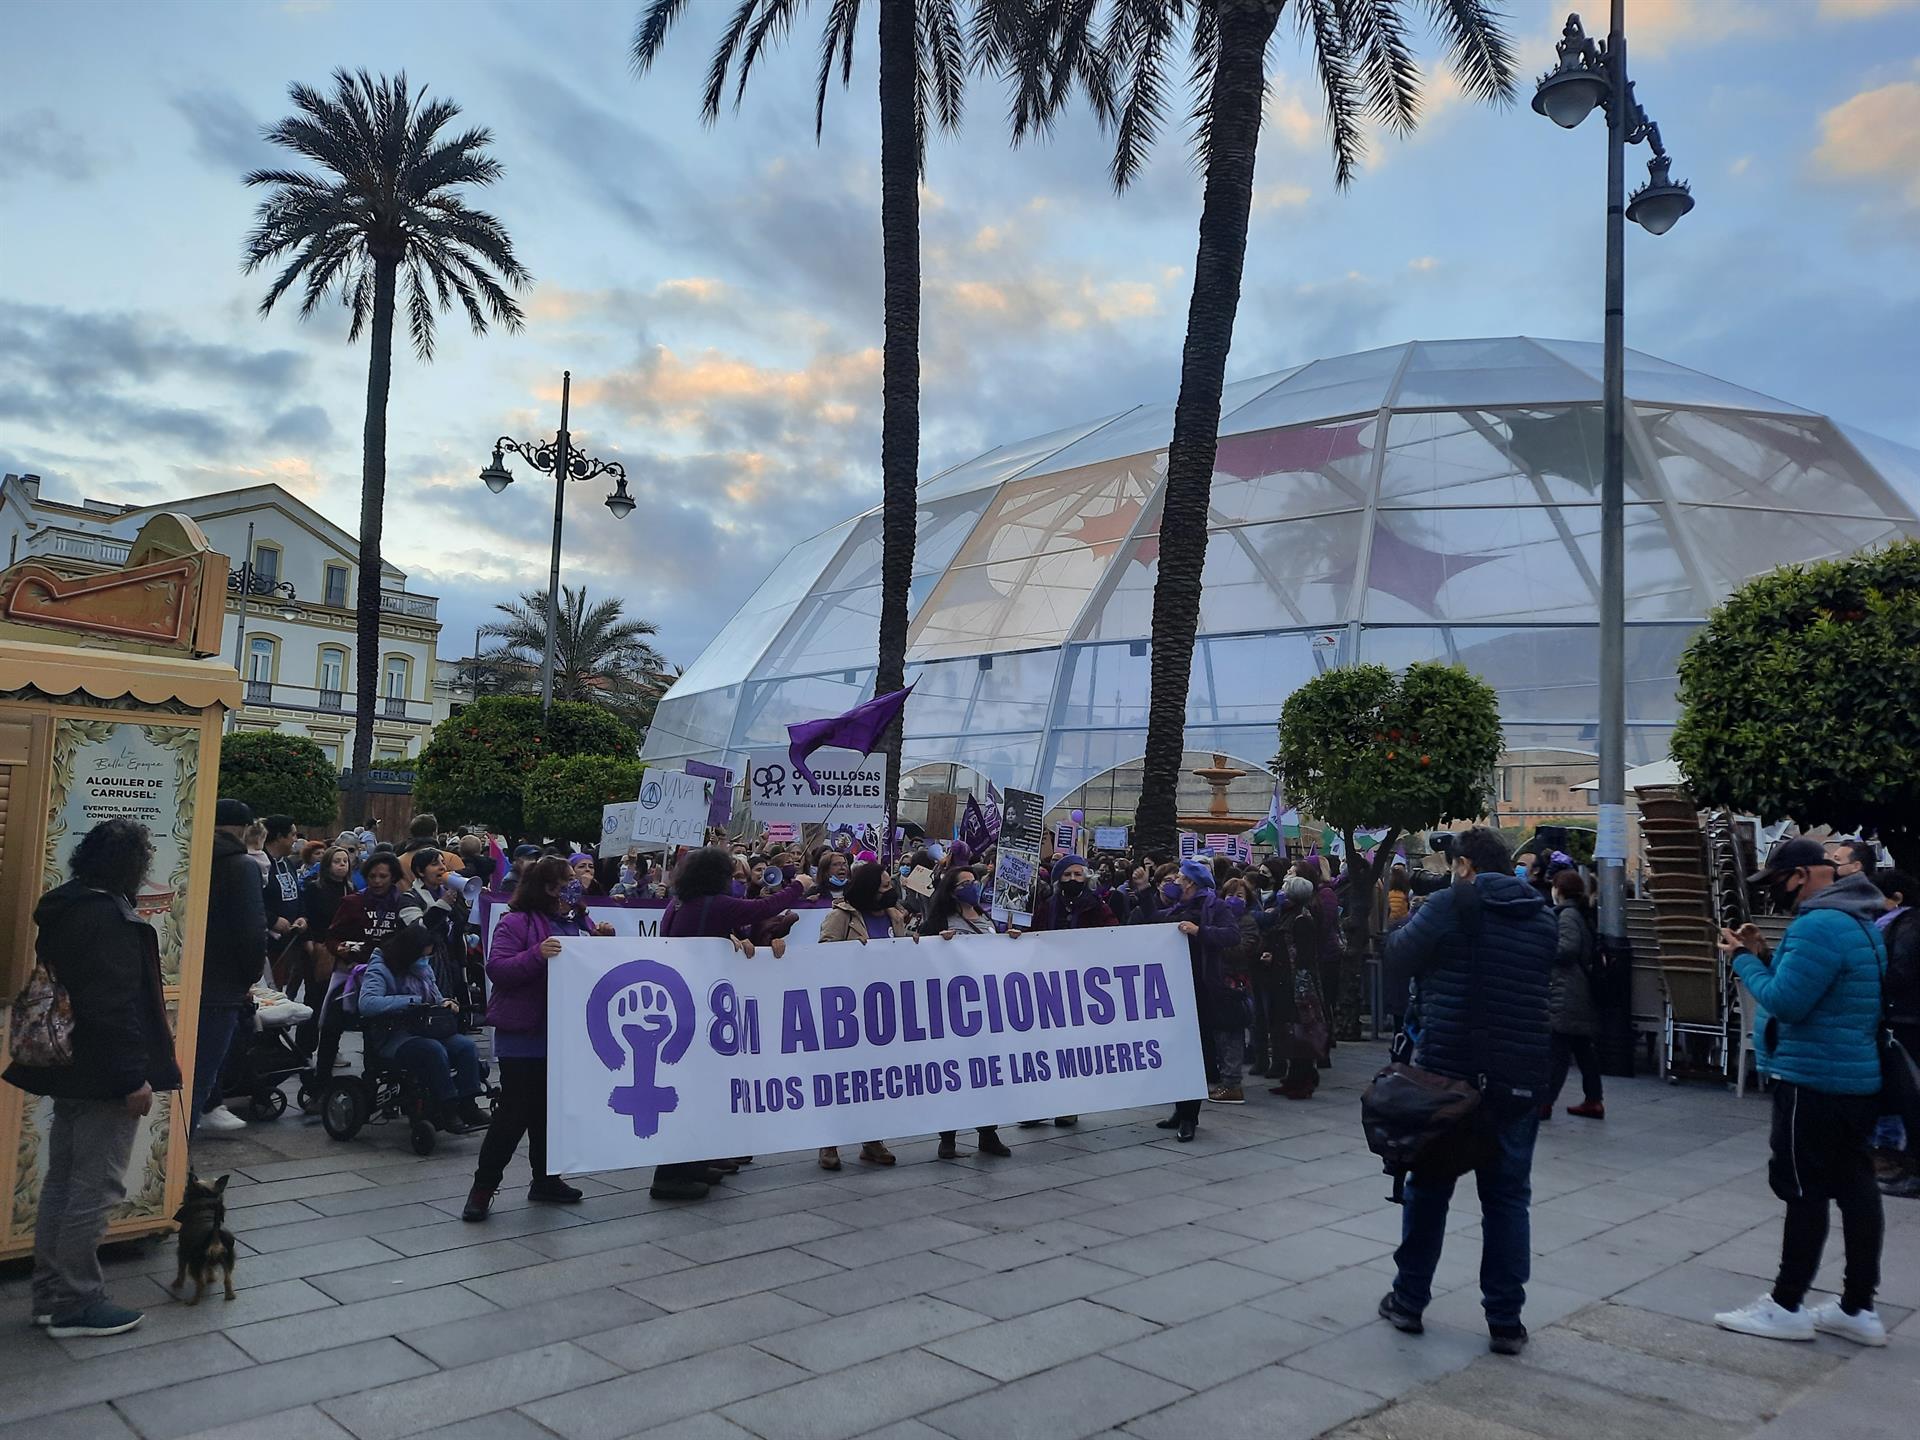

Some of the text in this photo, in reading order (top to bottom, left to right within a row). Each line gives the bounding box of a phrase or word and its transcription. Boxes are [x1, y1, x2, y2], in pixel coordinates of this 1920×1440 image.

[792, 770, 881, 781] OGULLOSAS
[86, 776, 164, 788] ALQUILER DE
[91, 788, 157, 799] CARRUSEL:
[792, 784, 803, 796] Y
[82, 805, 161, 814] EVENTOS, BAUTIZOS,
[366, 911, 396, 920] VOES
[780, 963, 1176, 1054] ABOLICIONISTA
[754, 1076, 805, 1113] LOS
[812, 1059, 962, 1107] DERECHOS
[968, 1055, 1004, 1089] DE
[1009, 1050, 1052, 1084] LAS
[1055, 1039, 1162, 1079] MUJERES
